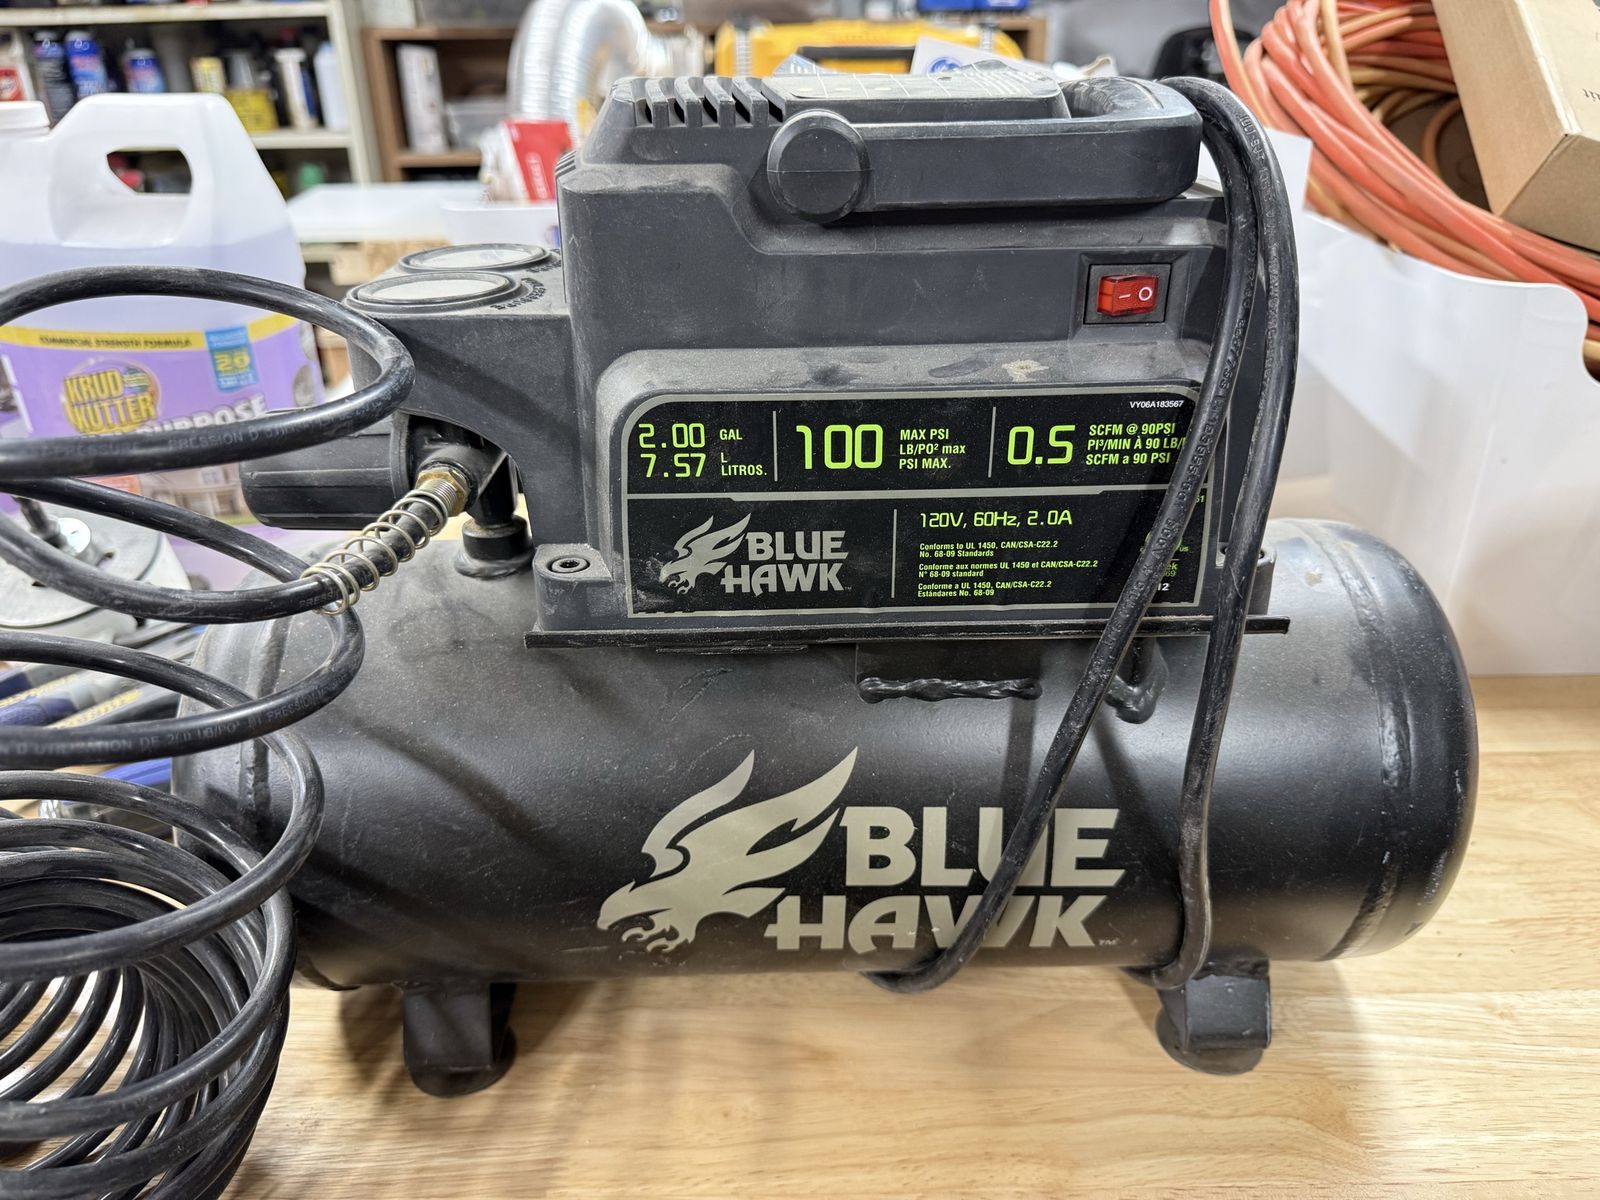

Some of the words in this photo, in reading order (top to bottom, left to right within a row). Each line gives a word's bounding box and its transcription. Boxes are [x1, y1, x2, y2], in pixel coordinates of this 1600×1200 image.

[64, 367, 124, 403] KRUD
[1129, 399, 1185, 409] VY06A183567
[72, 393, 157, 433] KUTTER
[136, 392, 266, 434] RPOSE
[638, 422, 706, 449] 2.00
[719, 428, 743, 441] GAL
[900, 428, 926, 441] MAX
[929, 428, 949, 440] PSI
[1088, 423, 1124, 437] SCFM
[1125, 423, 1139, 436] @
[795, 423, 884, 470] 100
[941, 444, 966, 455] max
[1007, 424, 1076, 466] 0.5
[1133, 435, 1143, 450] À
[1145, 437, 1160, 450] 90
[640, 452, 707, 478] 7.57
[720, 452, 728, 463] L
[899, 458, 918, 470] PSI
[921, 457, 952, 470] MAX.
[1085, 453, 1120, 466] SCFM
[1122, 455, 1130, 465] a
[1132, 452, 1148, 465] 90
[1150, 452, 1171, 464] PSI
[721, 464, 768, 476] LITROS.
[920, 511, 967, 529] 120V,
[973, 510, 1021, 528] 60Hz,
[1027, 509, 1073, 526] 2.0A
[746, 530, 849, 561] BLUE
[919, 542, 955, 551] Conforms
[956, 542, 964, 550] to
[965, 542, 975, 550] UL
[1000, 540, 1059, 549] CAN/CSA-C22.2
[919, 550, 932, 558] No.
[934, 550, 956, 558] 68-09
[957, 549, 994, 558] Standards
[918, 563, 954, 571] Conforme
[970, 562, 998, 570] normes
[999, 561, 1010, 570] UL
[1012, 561, 1030, 569] 1450
[1031, 561, 1039, 569] et
[1040, 560, 1099, 569] CAN/CSA-C22.2
[719, 562, 845, 597] HAWK
[929, 570, 951, 578] 68-09
[952, 569, 985, 578] standard
[917, 582, 953, 590] Conforme
[960, 582, 971, 590] UL
[995, 580, 1053, 590] CAN/CSA-C22.2
[958, 589, 971, 598] No.
[973, 588, 995, 597] 68-09
[839, 805, 1126, 888] BLUE
[763, 894, 1108, 955] HAWK
